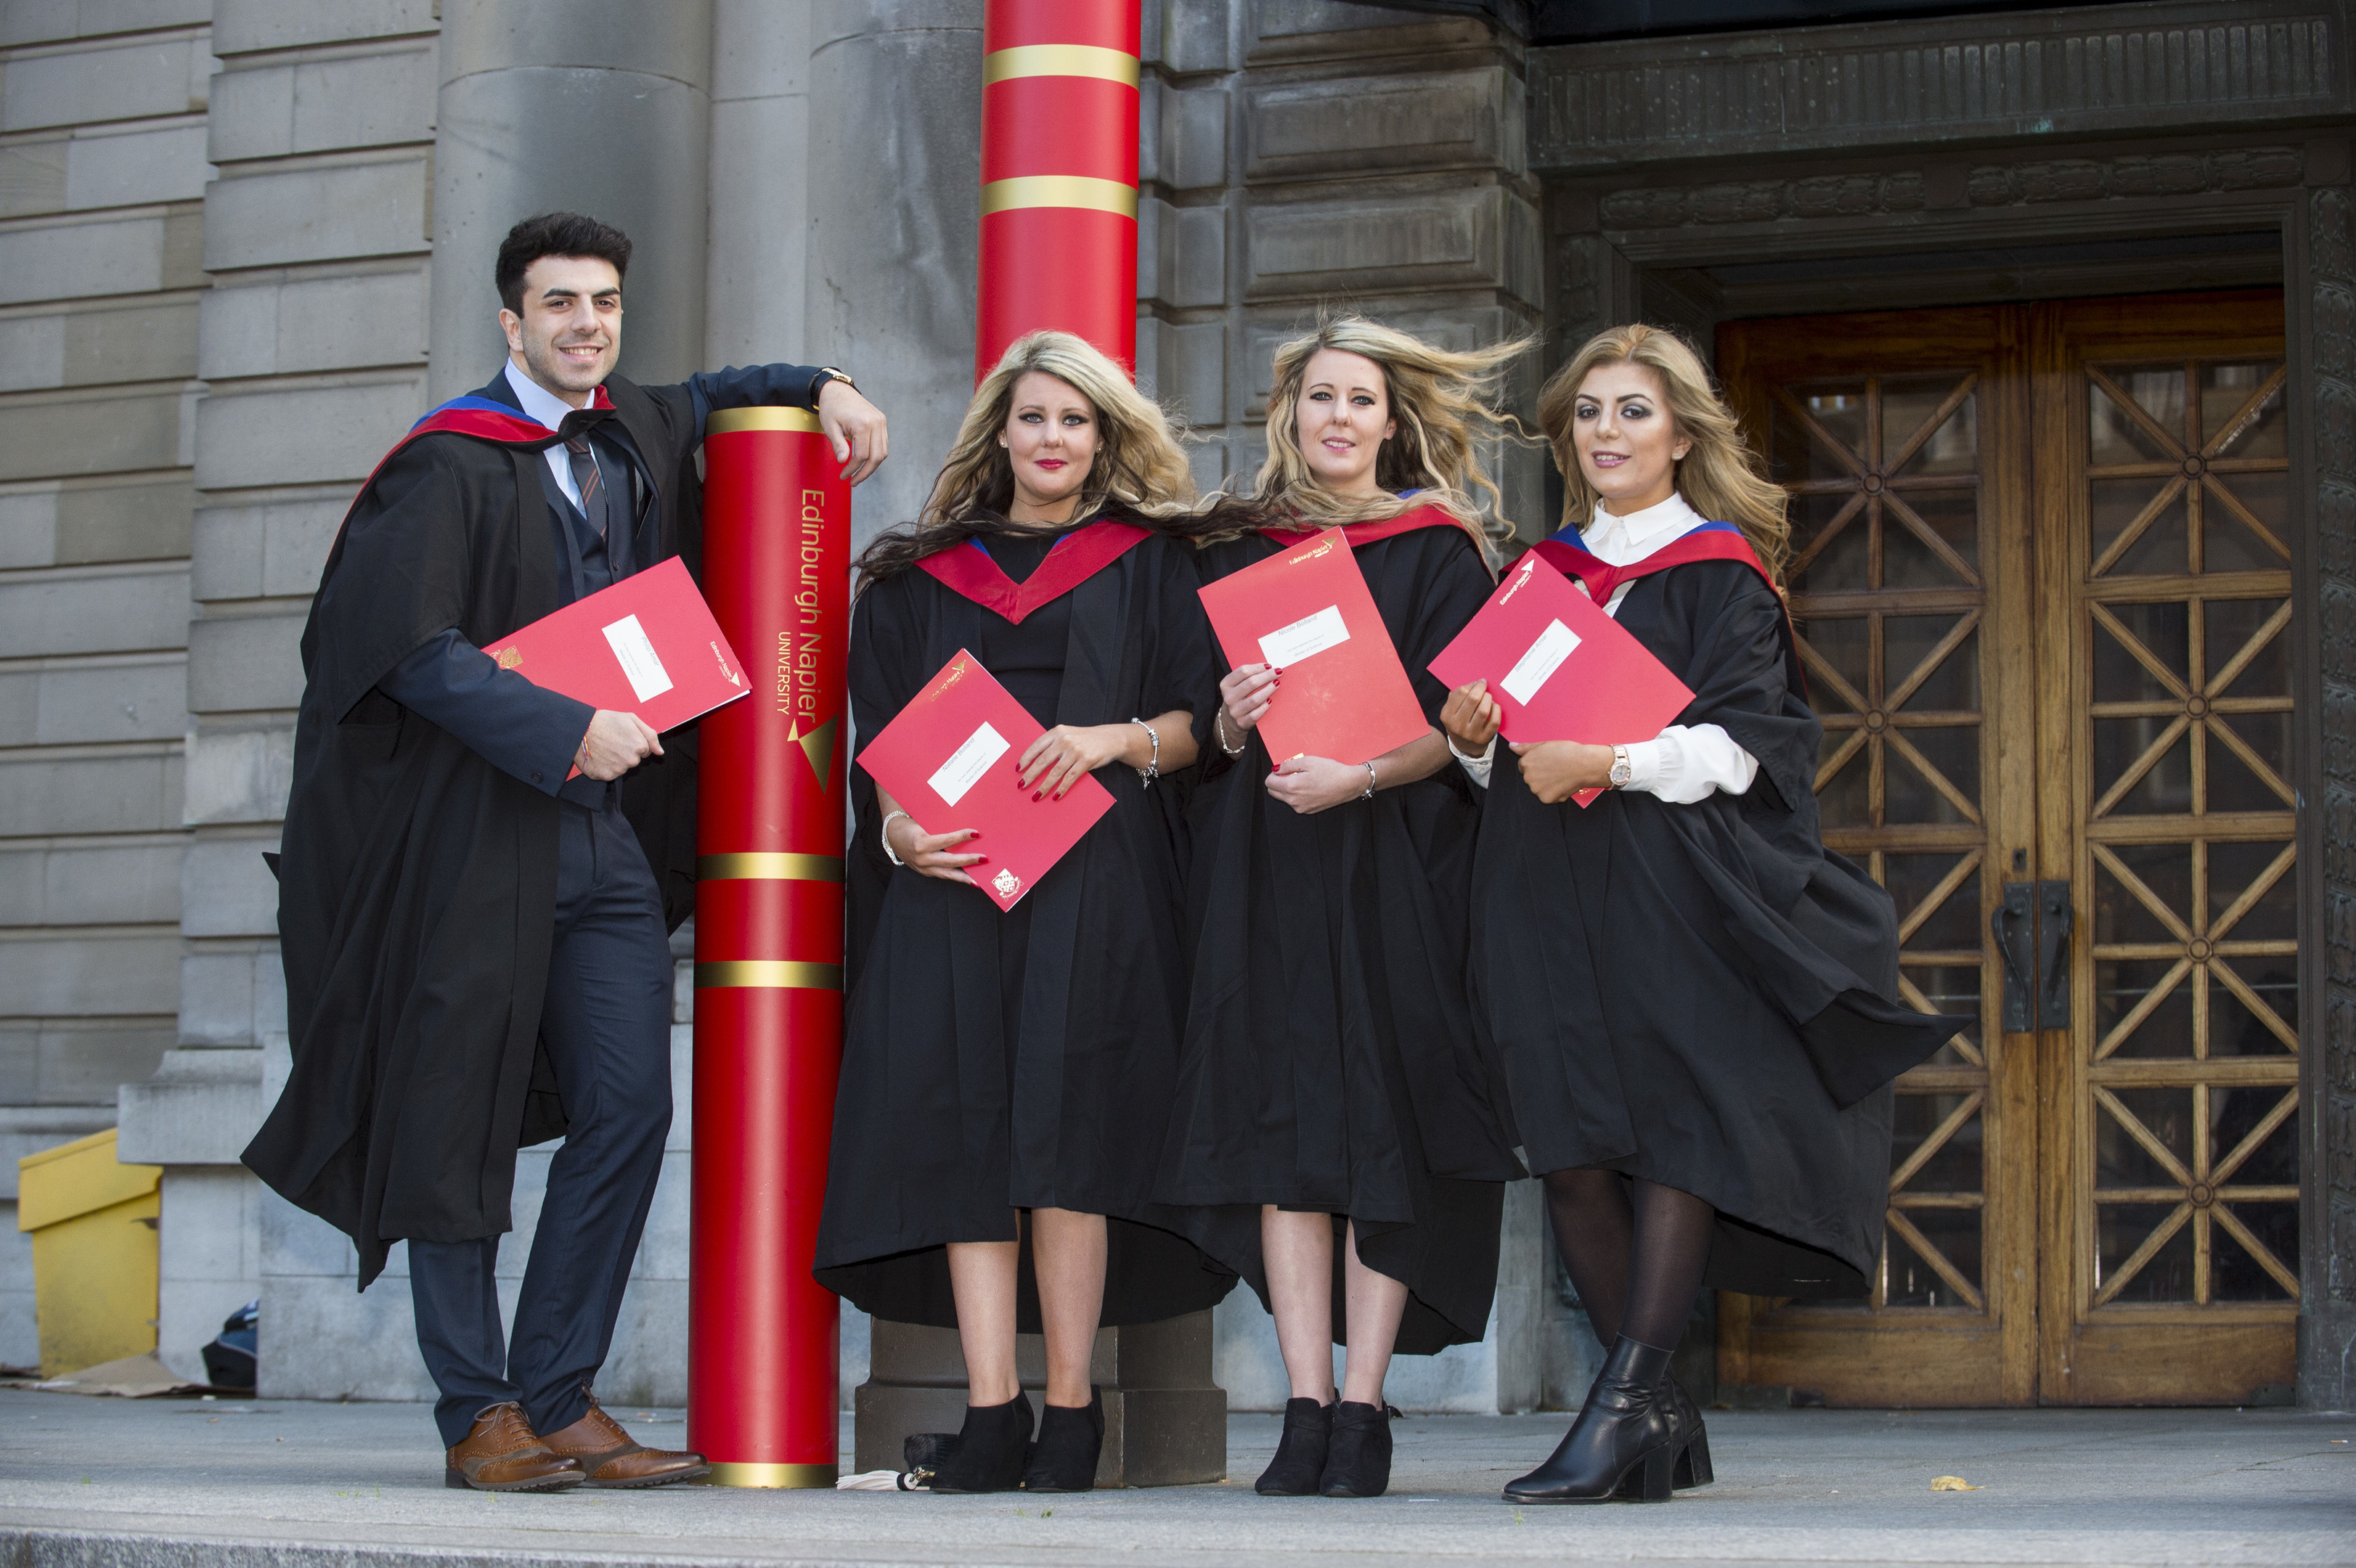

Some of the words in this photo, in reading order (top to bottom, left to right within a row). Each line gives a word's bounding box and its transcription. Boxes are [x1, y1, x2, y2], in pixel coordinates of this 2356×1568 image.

[795, 489, 825, 624] Edinburgh
[1499, 584, 1518, 605] Edinburgh
[1278, 626, 1295, 636] Nicole
[1296, 614, 1318, 629] Bolland
[641, 637, 651, 652] Philip
[650, 653, 659, 665] Amar
[710, 641, 724, 663] Edinburgh
[722, 663, 733, 678] Napier
[1515, 648, 1536, 672] Stephanie
[1535, 634, 1546, 648] Amar
[777, 631, 791, 716] UNIVERSITY
[794, 633, 821, 724] Napier
[942, 755, 958, 771] Natalie
[958, 737, 975, 756] Bolland
